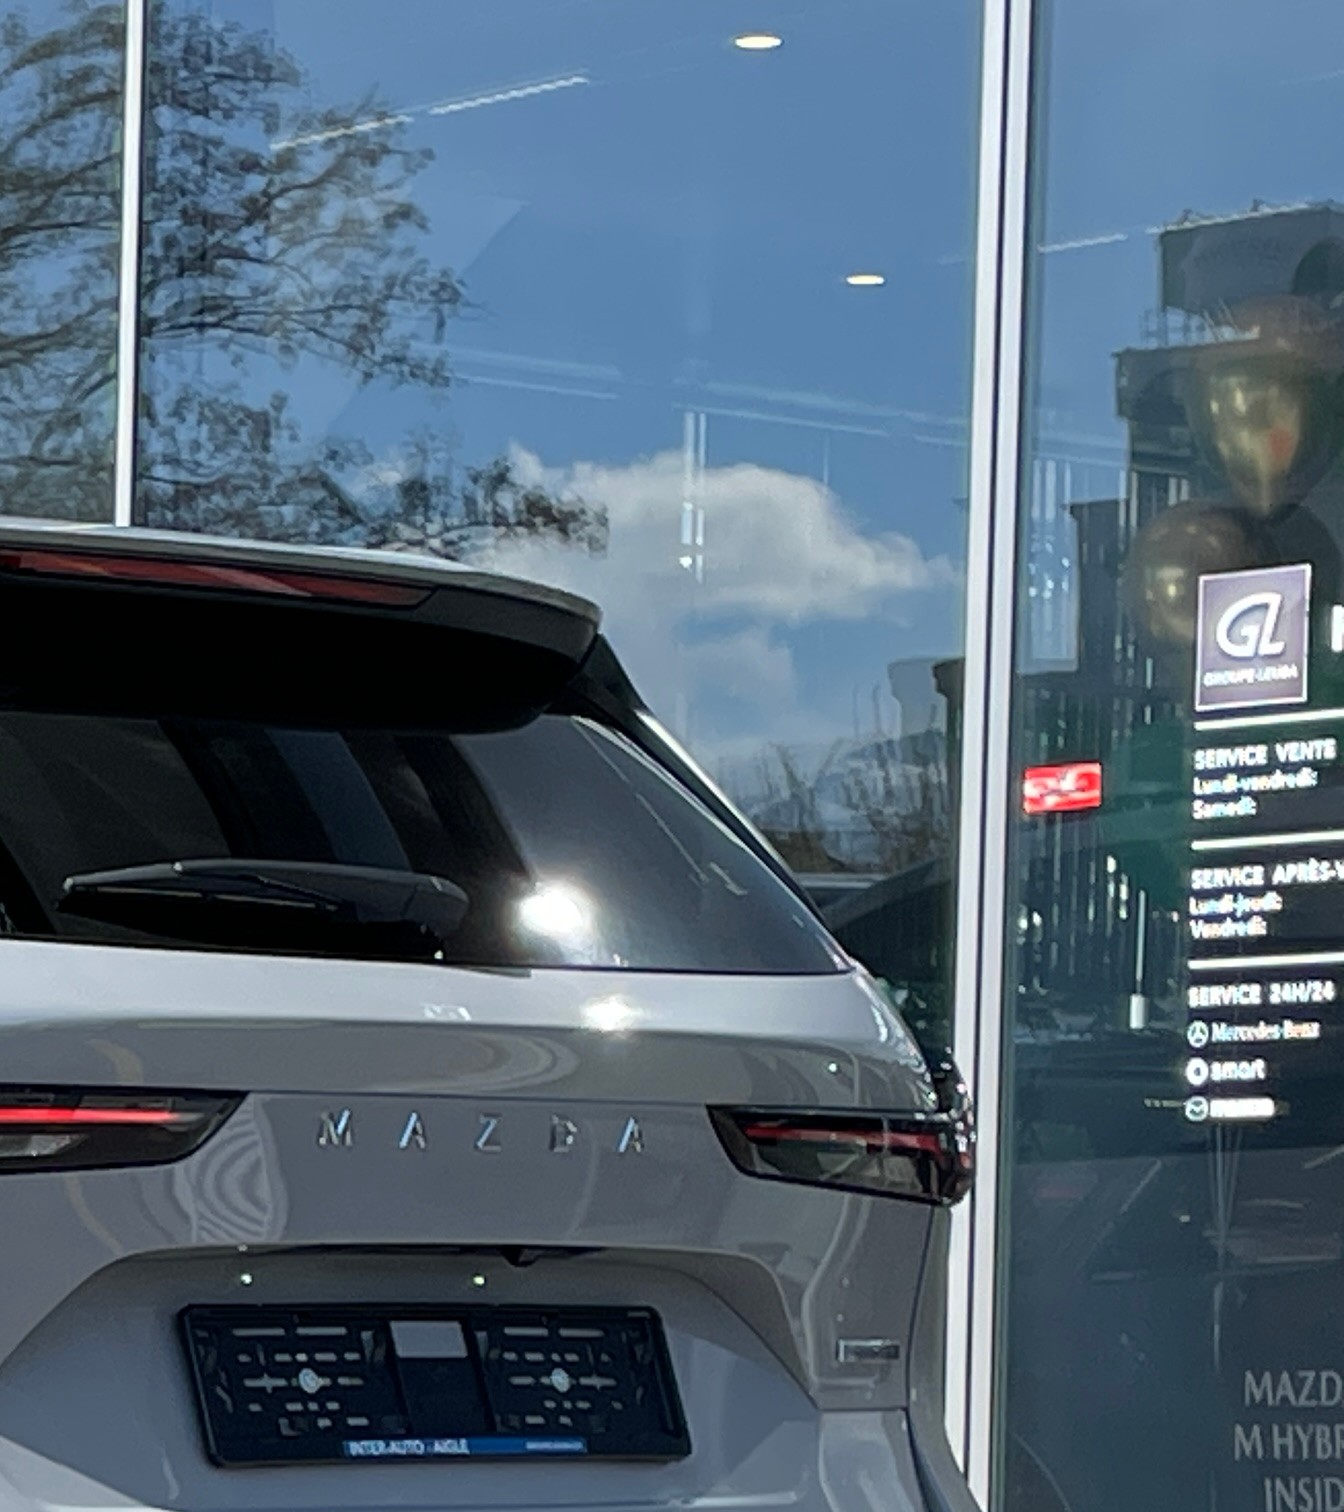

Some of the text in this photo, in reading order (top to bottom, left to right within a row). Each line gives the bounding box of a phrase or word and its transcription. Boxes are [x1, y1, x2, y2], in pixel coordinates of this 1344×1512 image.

[1216, 592, 1286, 659] GL
[1194, 738, 1337, 770] SERVICE VENTE
[1191, 866, 1265, 890] SERVICE
[1188, 980, 1336, 1009] SERVICE 24H/24
[318, 1108, 645, 1153] MAZDA
[1243, 1369, 1344, 1408] MAZD
[1234, 1422, 1263, 1461] M
